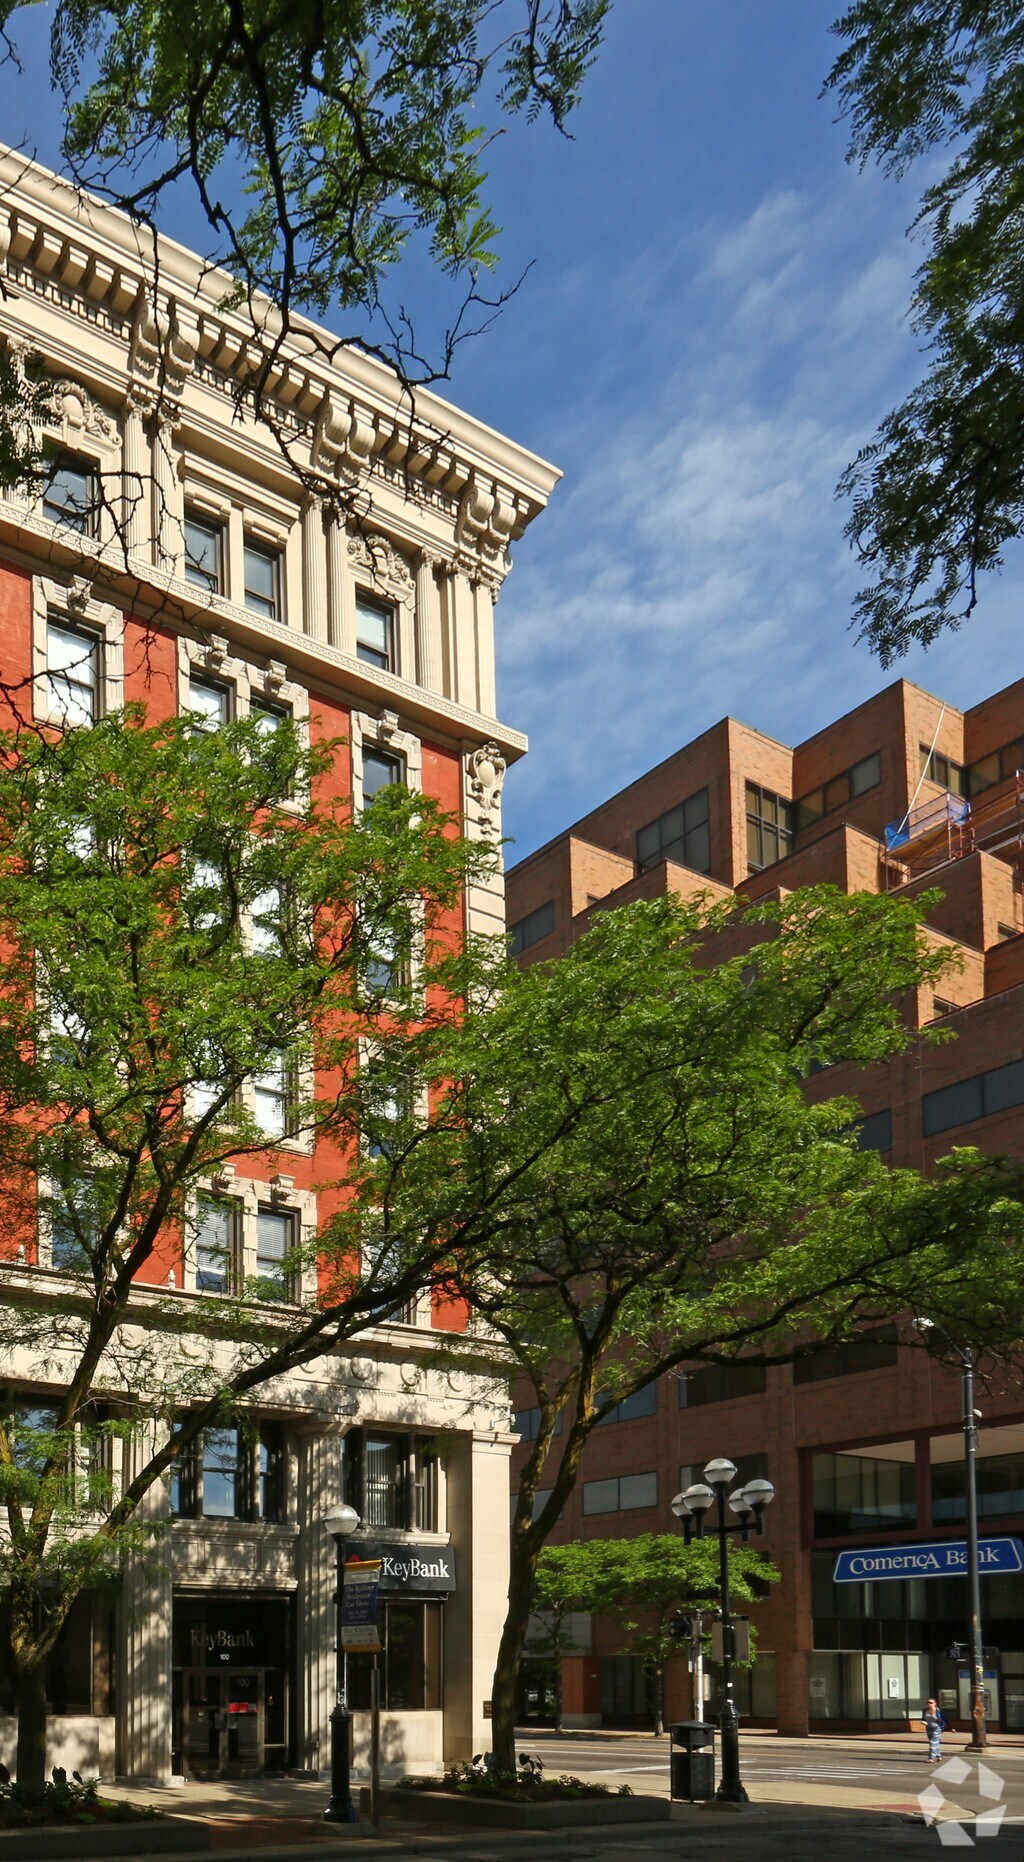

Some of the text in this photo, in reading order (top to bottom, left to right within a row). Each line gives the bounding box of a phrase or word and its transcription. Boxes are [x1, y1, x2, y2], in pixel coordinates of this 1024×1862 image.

[383, 1557, 450, 1581] KeyBank
[190, 1629, 255, 1651] KeyBank
[219, 1653, 230, 1661] 100
[236, 1678, 250, 1687] 100
